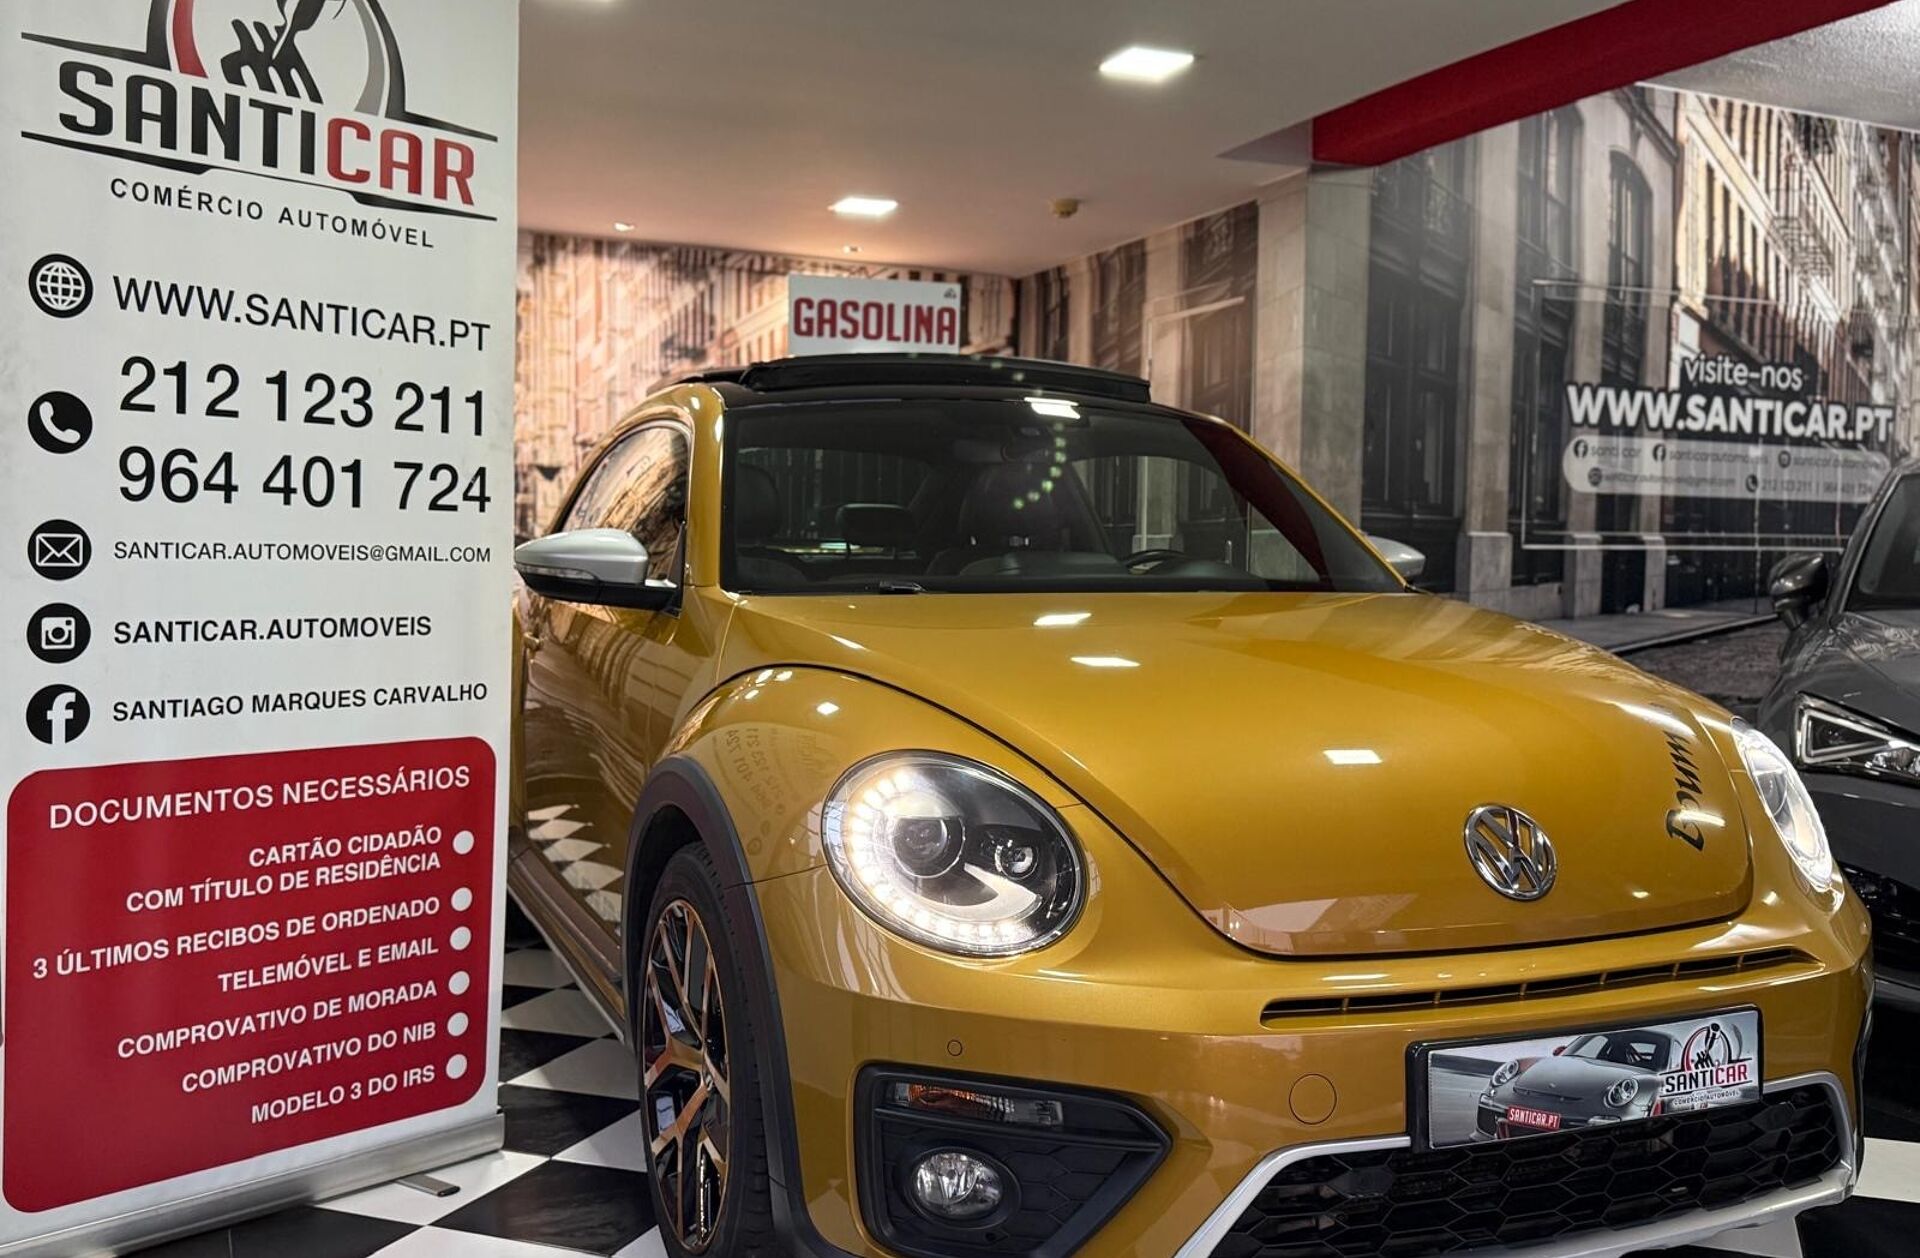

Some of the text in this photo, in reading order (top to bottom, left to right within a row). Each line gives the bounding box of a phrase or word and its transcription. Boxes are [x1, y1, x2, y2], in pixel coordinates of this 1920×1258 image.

[59, 61, 475, 206] SANTICAR
[110, 177, 434, 248] COMÉRCIO AUTOMÓVEL
[113, 275, 491, 351] WWW.SANTICAR.PT
[793, 297, 957, 345] GASOLINA
[120, 356, 484, 436] 212 123 211
[1684, 355, 1803, 390] visite-nos
[1567, 386, 1893, 442] WWW.SANTICAR.PT
[119, 446, 492, 513] 964 401 724
[114, 541, 491, 563] SANTICAR.AUTOMOVEIS@GMAIL.COM
[114, 616, 432, 643] SANTICAR.AUTOMOVEIS
[113, 683, 488, 721] SANTIAGO MARQUES CARVALHO
[49, 766, 471, 829] DOCUMENTOS NECESSÁRIOS
[249, 826, 442, 868] CARTÃO CIDADÃO
[126, 851, 441, 912] COM TÍTULO DE RESIDÊNCIA
[33, 896, 440, 979] 3 ÚLTIMOS RECIBOS DE ORDENADO
[218, 936, 439, 992] TELEMÓVEL E EMAIL
[117, 979, 438, 1058] COMPROVATIVO DE MORADA
[182, 1021, 437, 1092] COMPROVATIVO DO NIB
[1665, 1064, 1748, 1093] SANTICAR
[251, 1064, 436, 1123] MODELO 3 DO IRS
[1509, 1108, 1558, 1128] SANTICAR.PT
